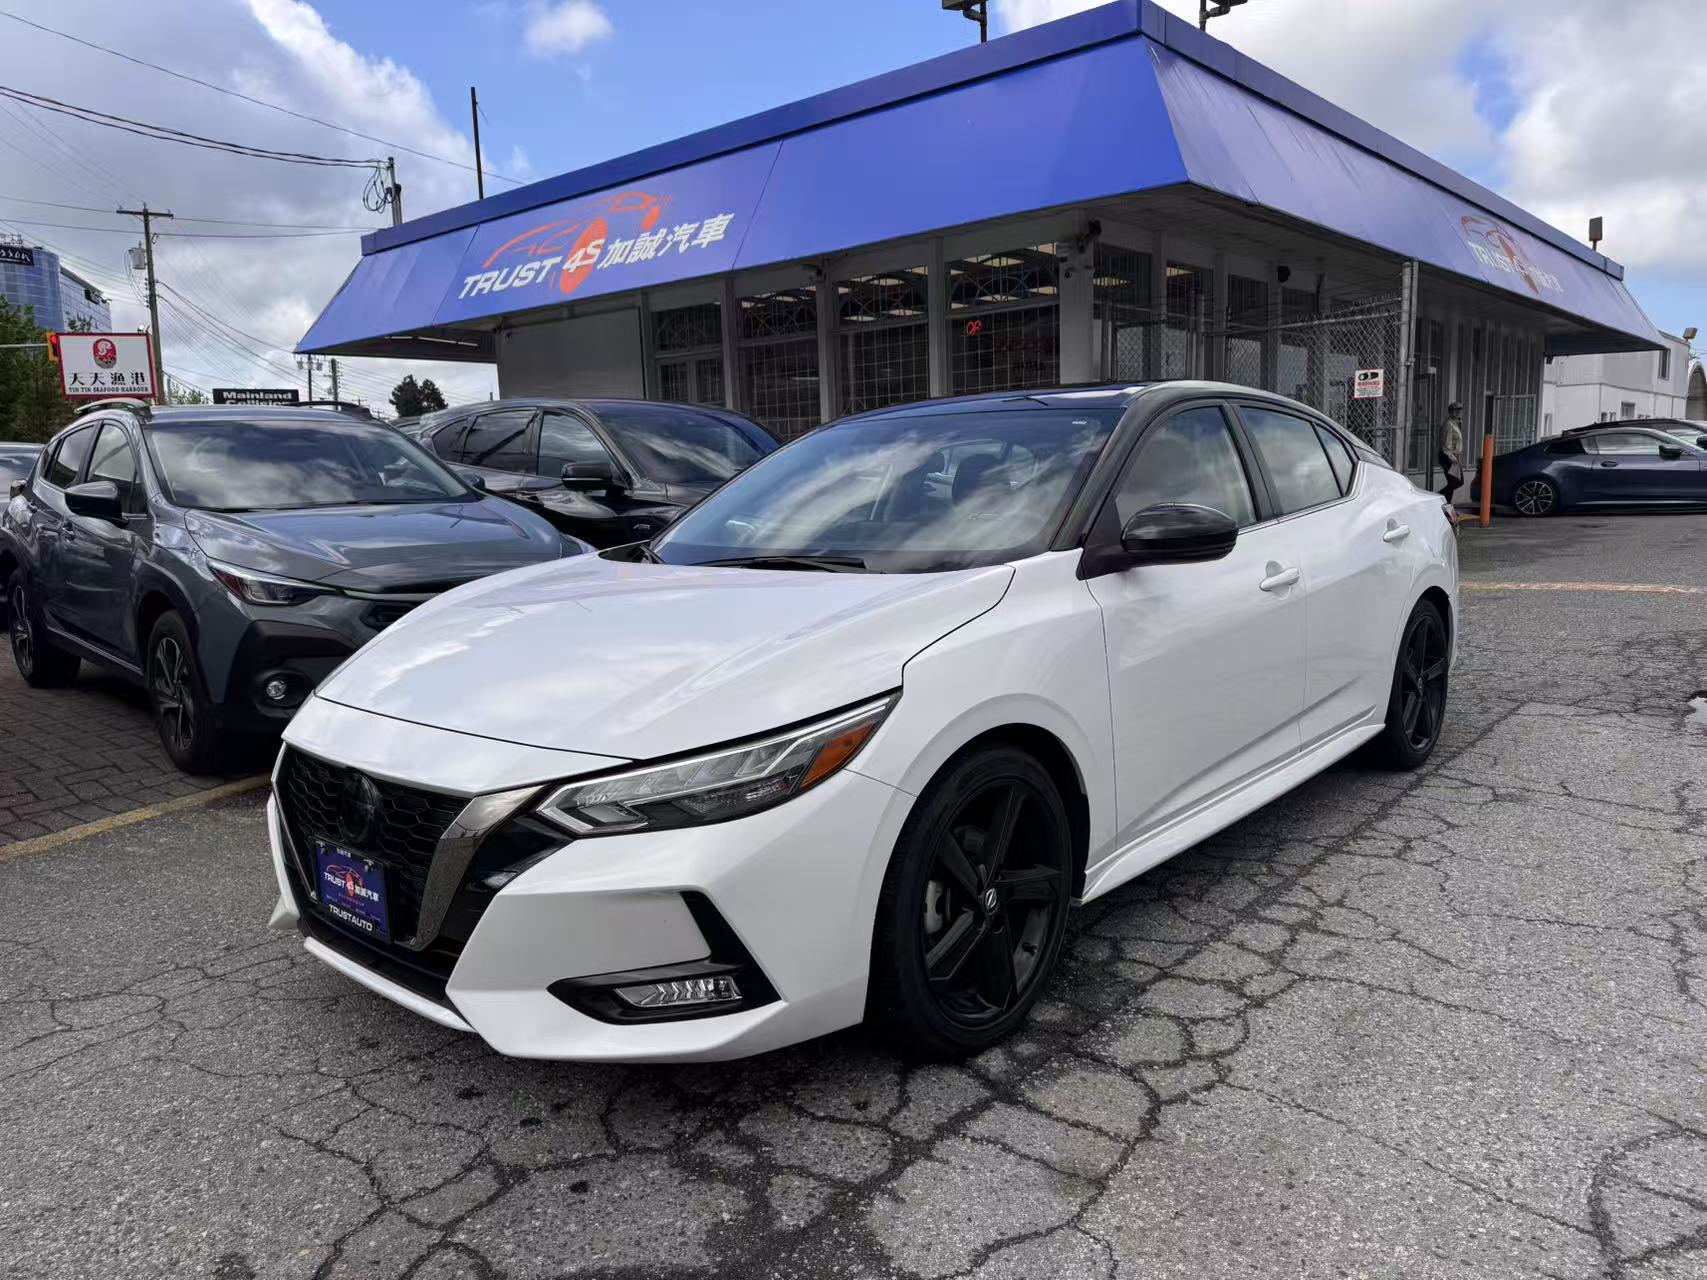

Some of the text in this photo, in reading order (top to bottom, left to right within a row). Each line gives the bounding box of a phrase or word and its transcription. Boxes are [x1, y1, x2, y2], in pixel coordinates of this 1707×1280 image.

[458, 213, 735, 299] TRUST 4S 加誠汽車
[69, 371, 145, 386] 天天漁港
[222, 391, 292, 399] Mainland
[323, 872, 346, 888] TRUST
[328, 904, 373, 932] TRUSTAUTO
